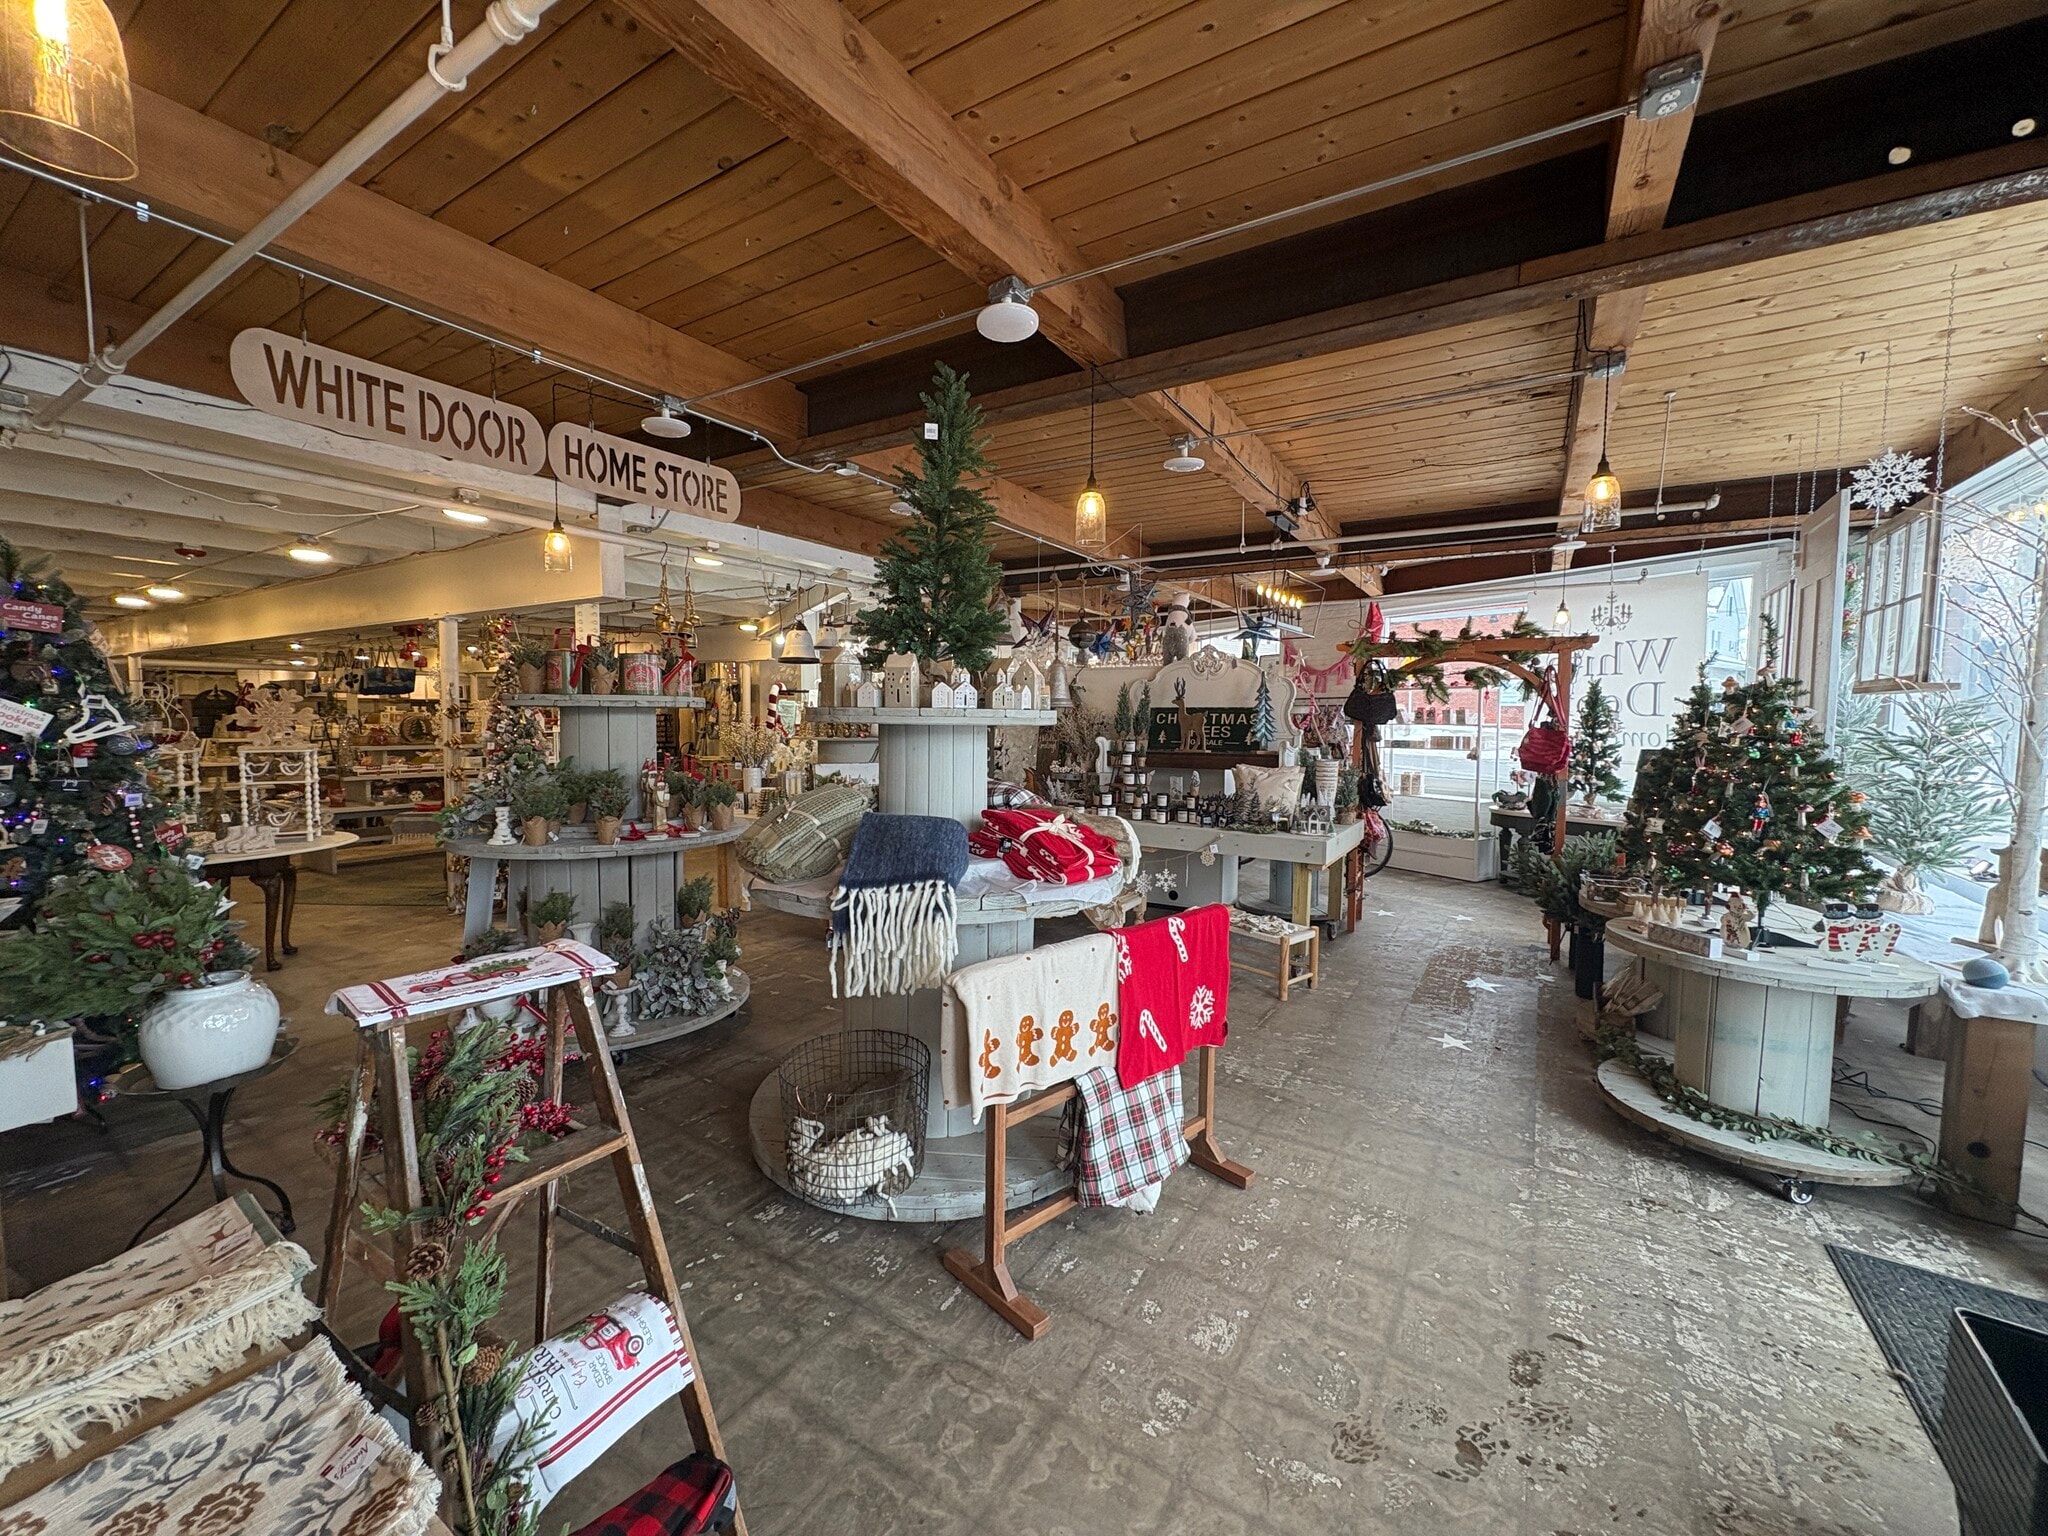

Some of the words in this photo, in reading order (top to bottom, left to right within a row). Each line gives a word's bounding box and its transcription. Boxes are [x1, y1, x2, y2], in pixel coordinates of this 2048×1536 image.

[262, 343, 406, 436] WHITE
[418, 389, 528, 466] DOOR
[564, 434, 647, 495] HOME
[654, 461, 728, 515] STORE
[3, 603, 43, 614] Candy
[22, 612, 59, 621] Canes
[0, 703, 46, 722] hristmas
[0, 711, 42, 730] ookies
[1156, 713, 1258, 725] CHTMAS
[588, 1362, 604, 1389] CEDAR
[595, 1354, 614, 1385] SPRUCE
